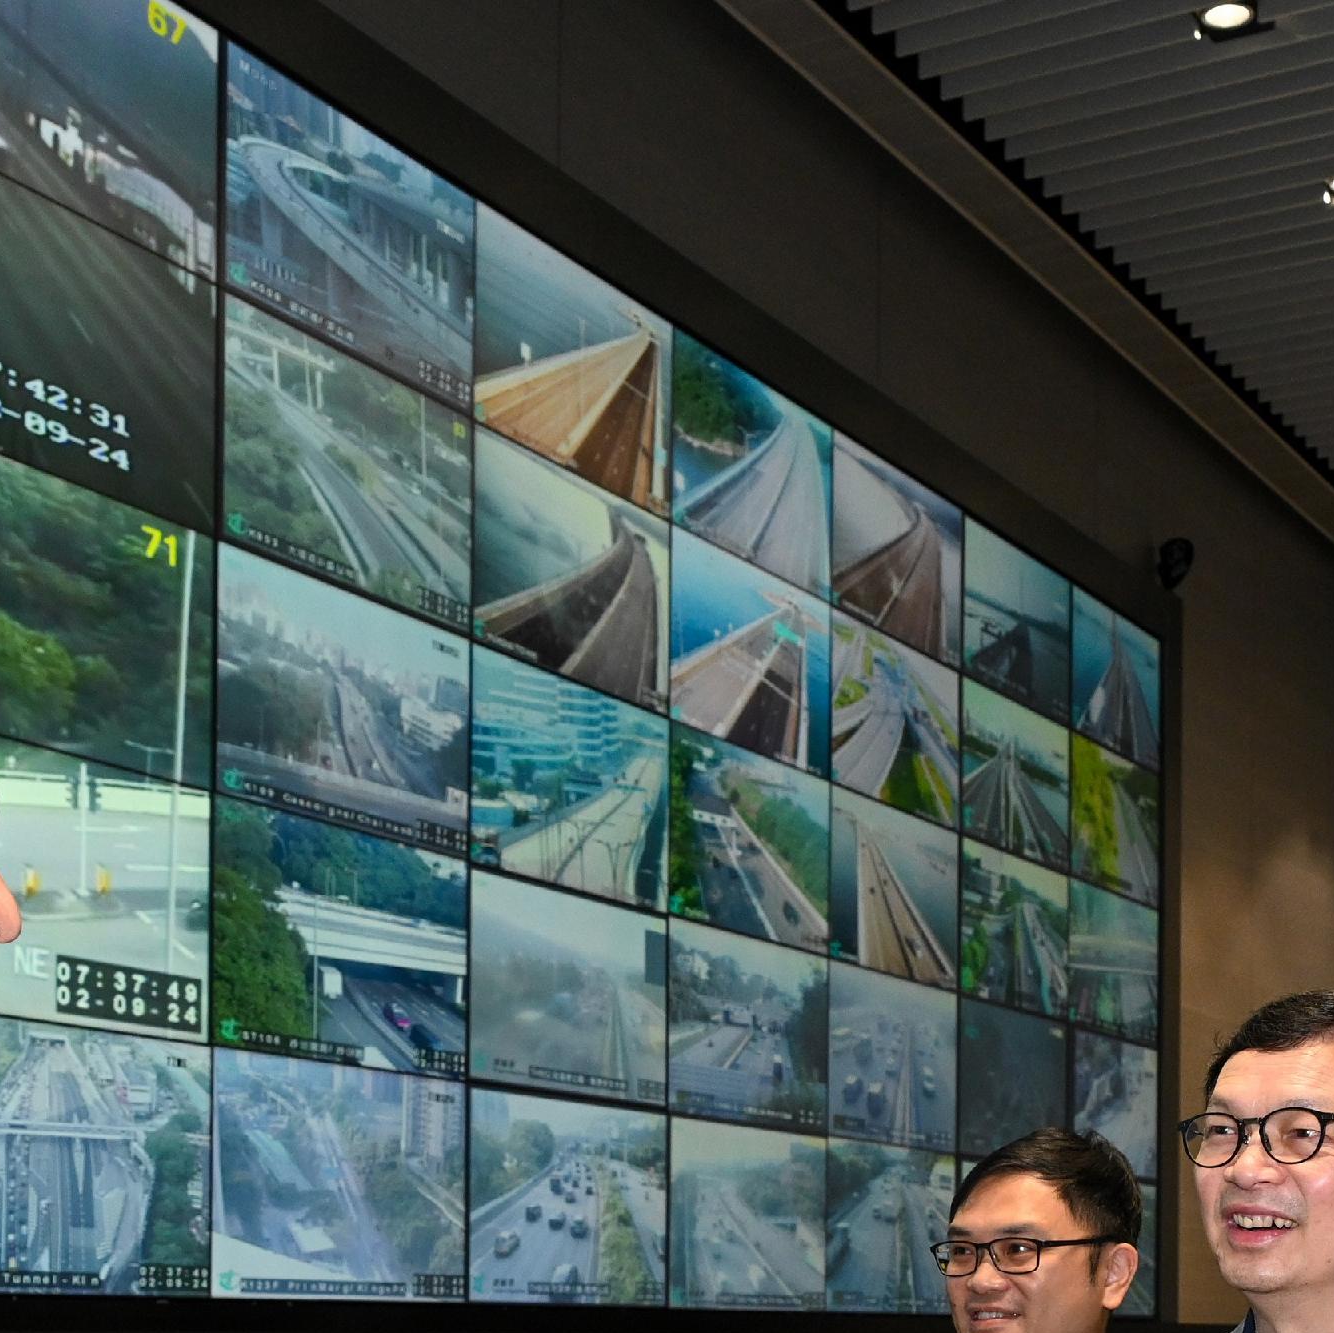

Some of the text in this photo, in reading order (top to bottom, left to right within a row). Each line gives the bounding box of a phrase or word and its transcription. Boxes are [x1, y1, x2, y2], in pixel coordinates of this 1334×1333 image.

[148, 0, 186, 46] 67
[140, 525, 177, 568] 71
[14, 945, 50, 980] NE
[56, 961, 199, 1004] 07:37:49
[56, 985, 198, 1025] 02-09-24
